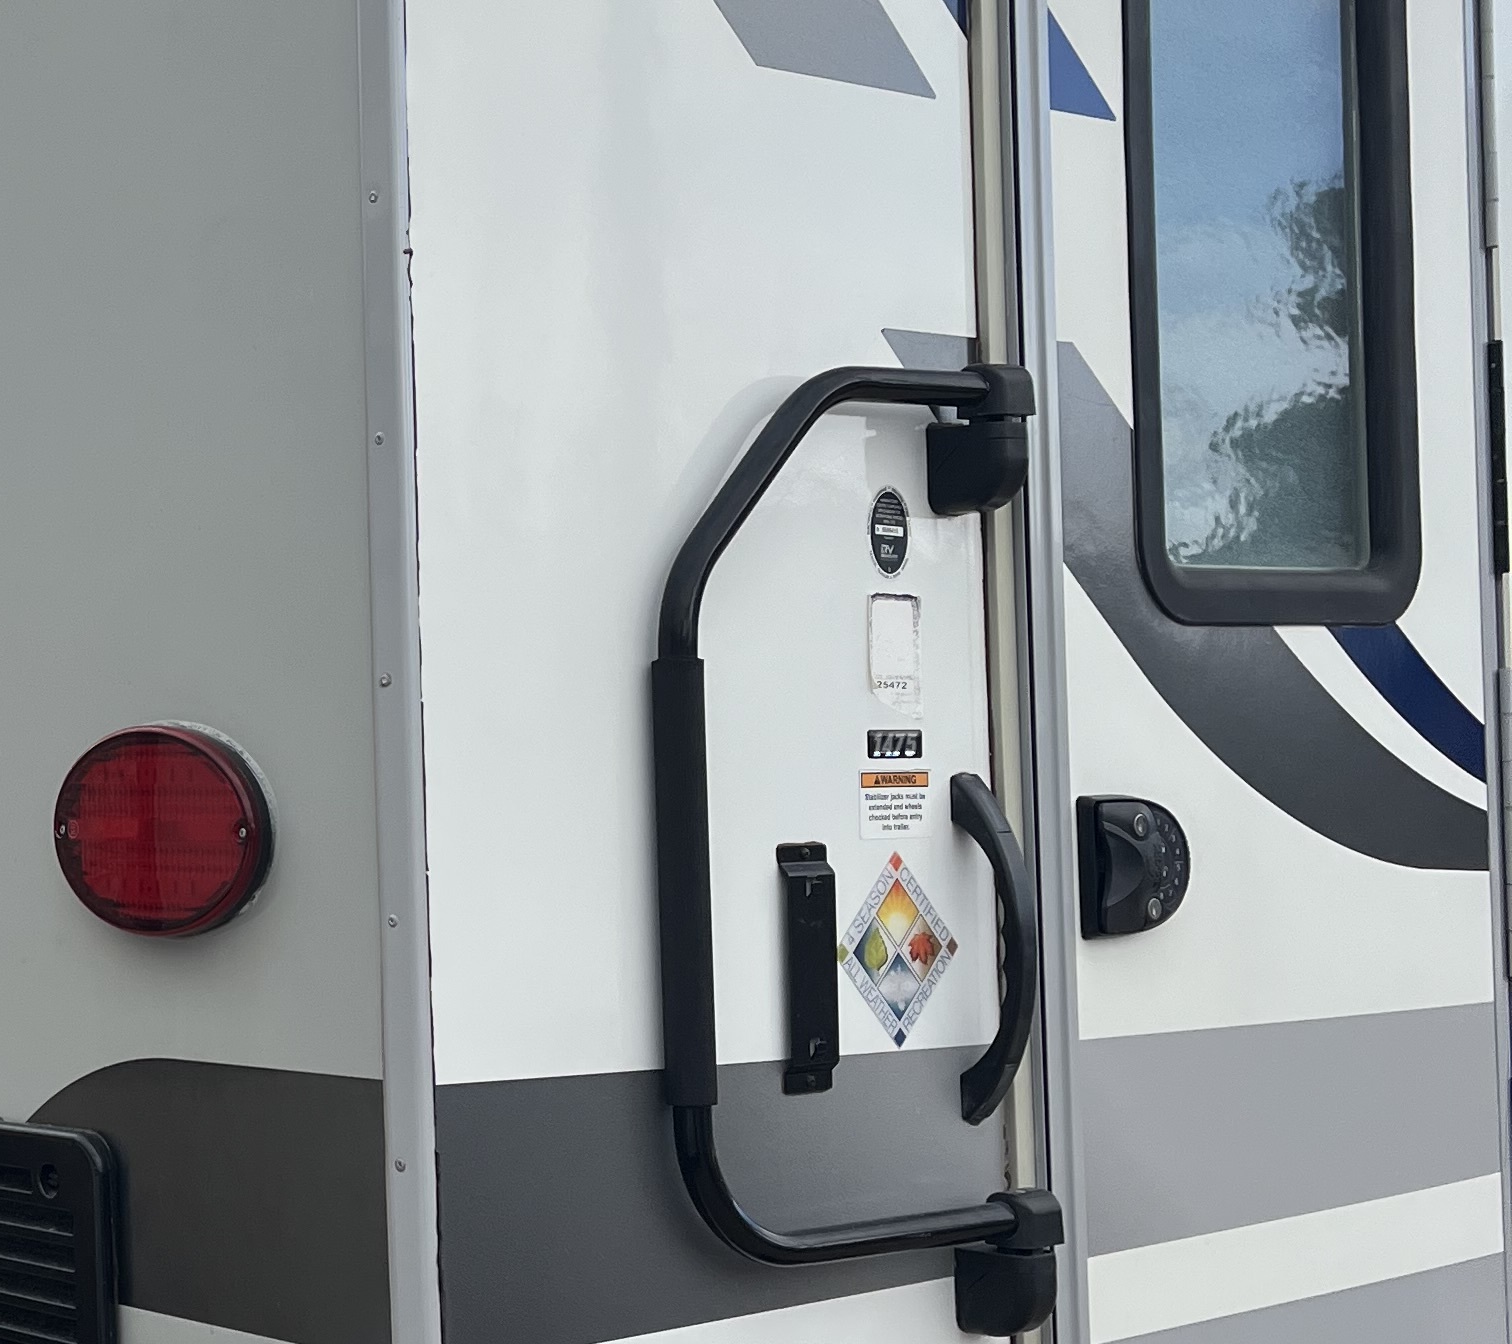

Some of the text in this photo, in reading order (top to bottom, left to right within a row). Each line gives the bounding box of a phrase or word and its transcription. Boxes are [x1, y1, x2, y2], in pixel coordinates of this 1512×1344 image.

[876, 680, 908, 690] 25472
[872, 732, 919, 757] 1475
[881, 775, 917, 785] WARNING
[853, 867, 894, 934] SEASON
[899, 867, 950, 942] CERTIFIED
[844, 957, 899, 1033] ALL WEATHER
[902, 948, 952, 1033] RECREATION
